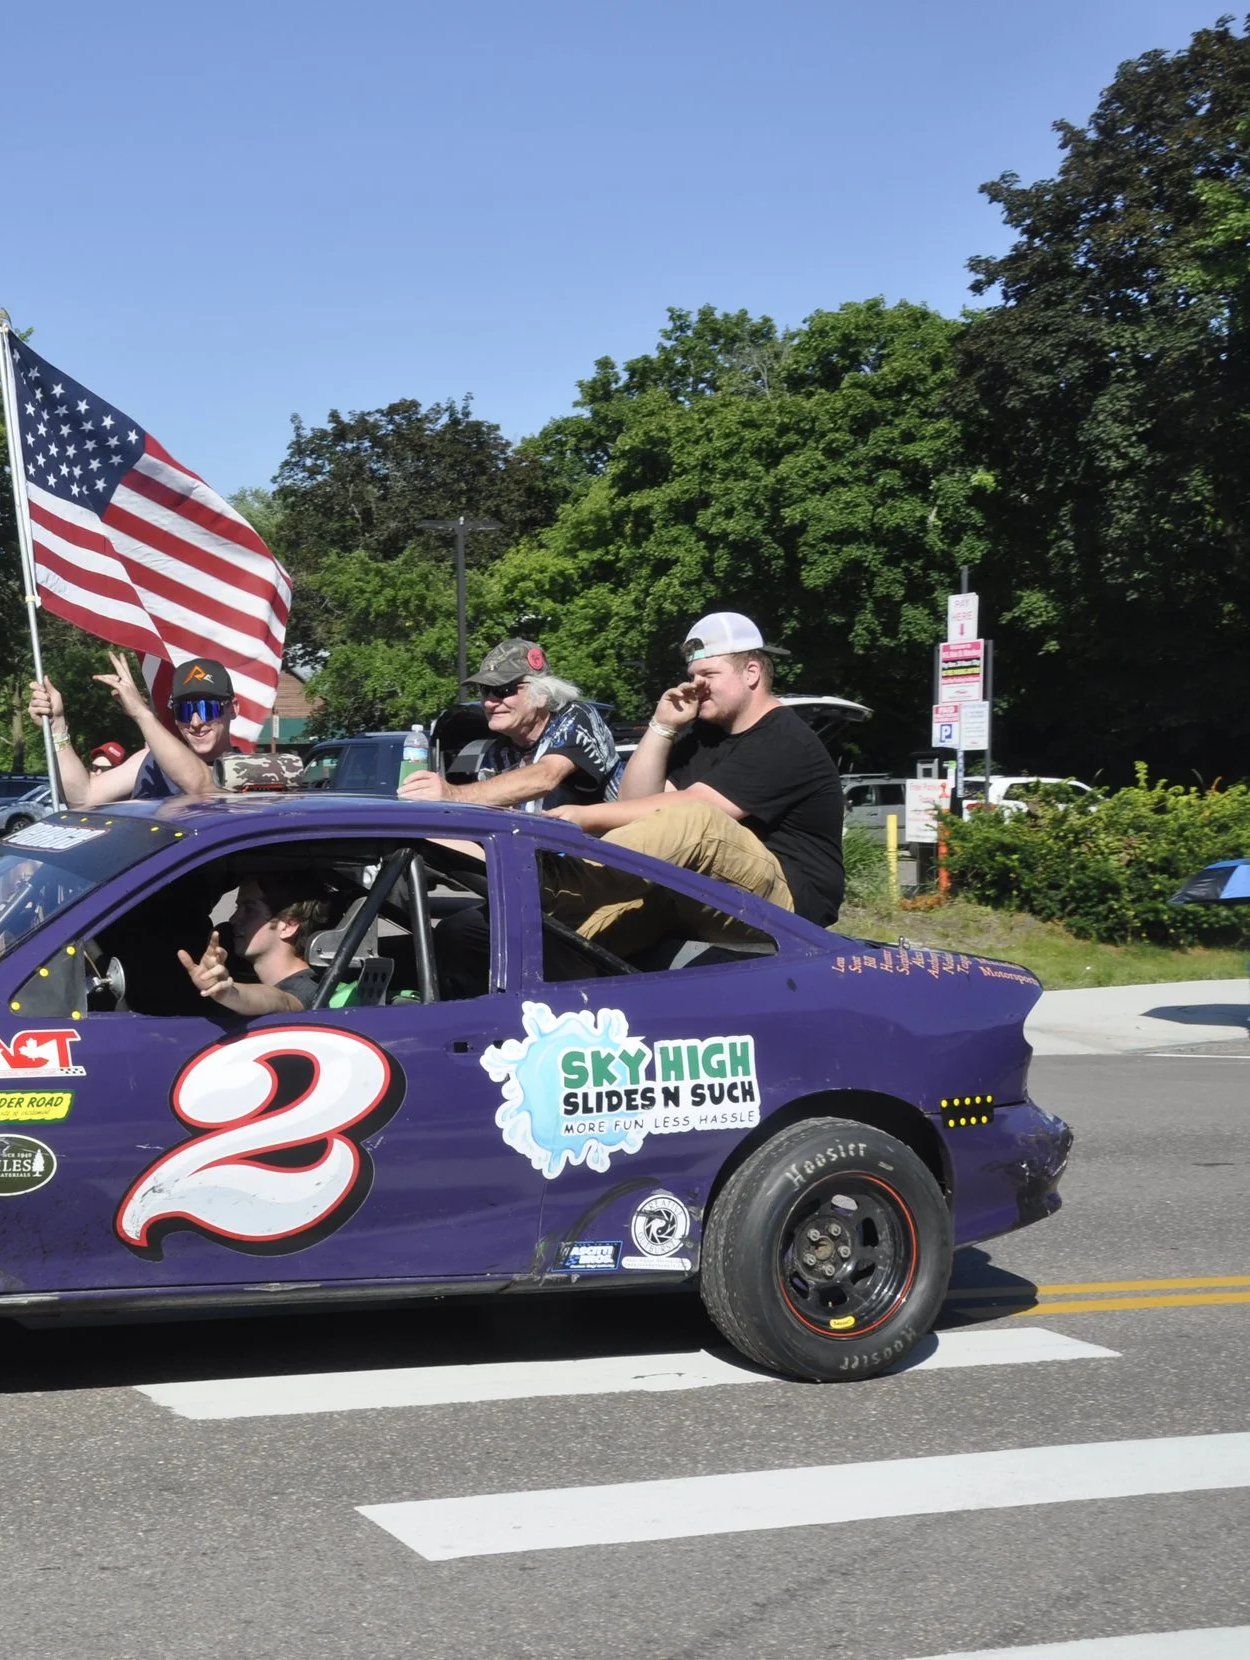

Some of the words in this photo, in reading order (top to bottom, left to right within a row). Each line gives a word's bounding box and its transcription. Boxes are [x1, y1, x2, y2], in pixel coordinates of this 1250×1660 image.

[561, 1049, 647, 1089] SKY
[659, 1041, 751, 1083] HIGH
[27, 1096, 64, 1108] ROAD
[563, 1087, 656, 1116] SLIDES
[661, 1086, 680, 1108] N
[691, 1081, 755, 1107] SUCH
[116, 1023, 391, 1248] 2
[563, 1122, 606, 1134] MORE
[614, 1119, 644, 1131] FUN
[654, 1116, 690, 1129] LESS
[699, 1111, 755, 1126] HASSLE
[784, 1142, 868, 1192] Hoosier
[840, 1327, 917, 1372] Hoosier
